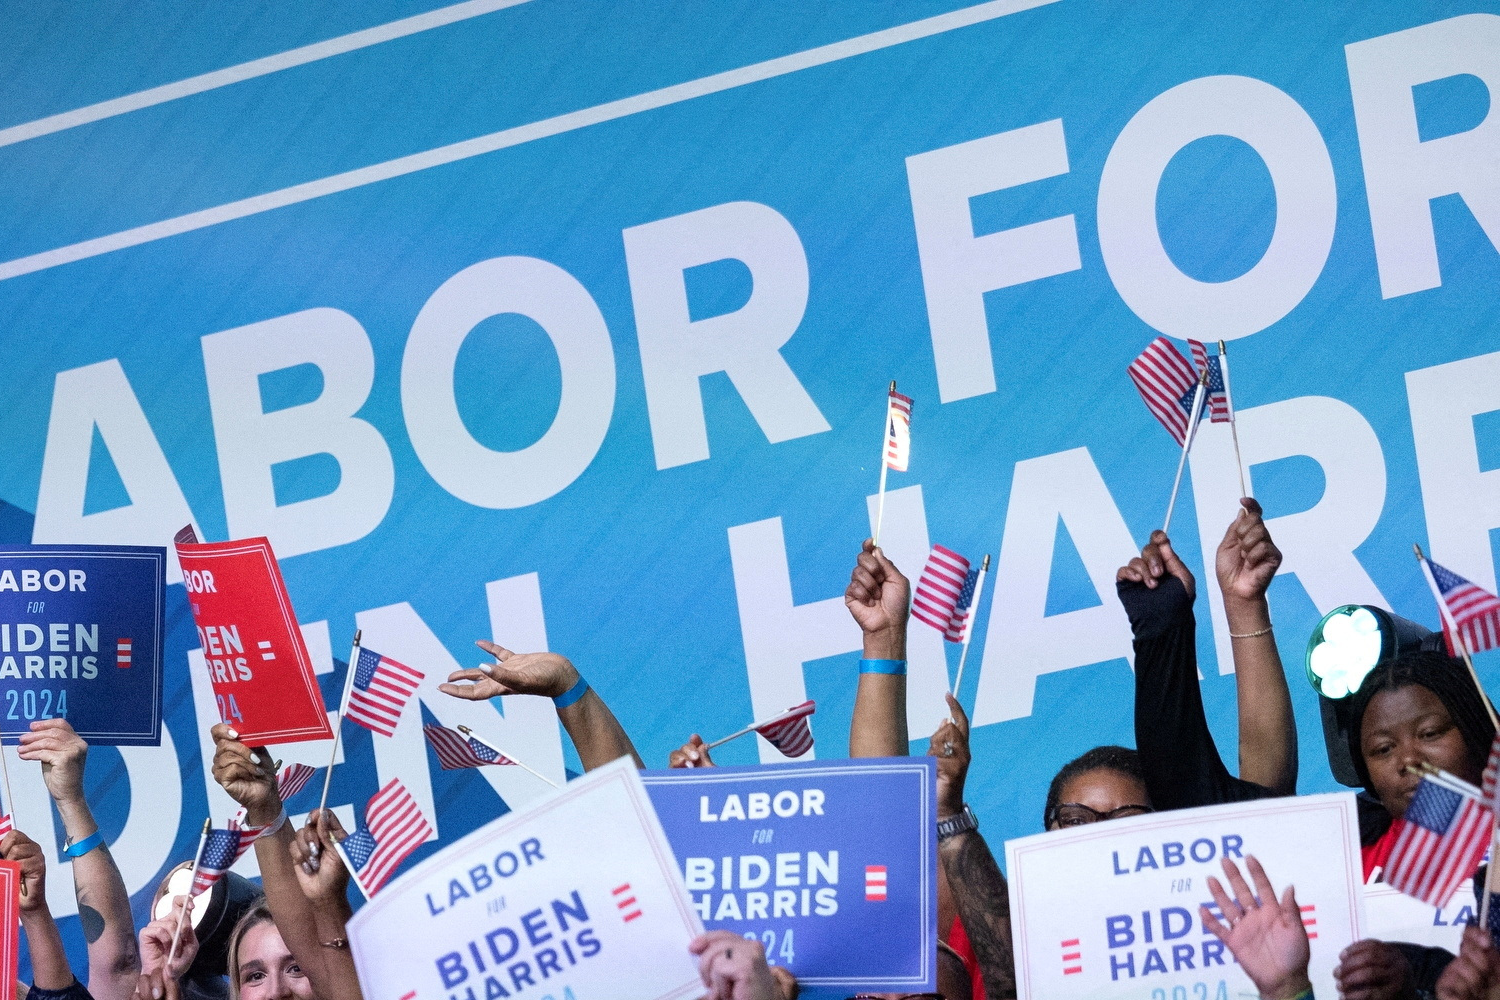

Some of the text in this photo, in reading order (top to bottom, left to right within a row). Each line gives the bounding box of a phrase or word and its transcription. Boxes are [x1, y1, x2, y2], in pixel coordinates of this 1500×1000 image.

[904, 12, 1500, 405] FOR
[26, 601, 45, 614] FOR
[6, 689, 68, 721] 2024
[700, 789, 826, 823] LABOR
[752, 829, 774, 844] FOR
[1112, 834, 1244, 876] LABOR
[425, 837, 546, 917] LABOR
[685, 850, 839, 890] BIDEN
[1170, 878, 1192, 894] FOR
[435, 889, 590, 990] BIDEN
